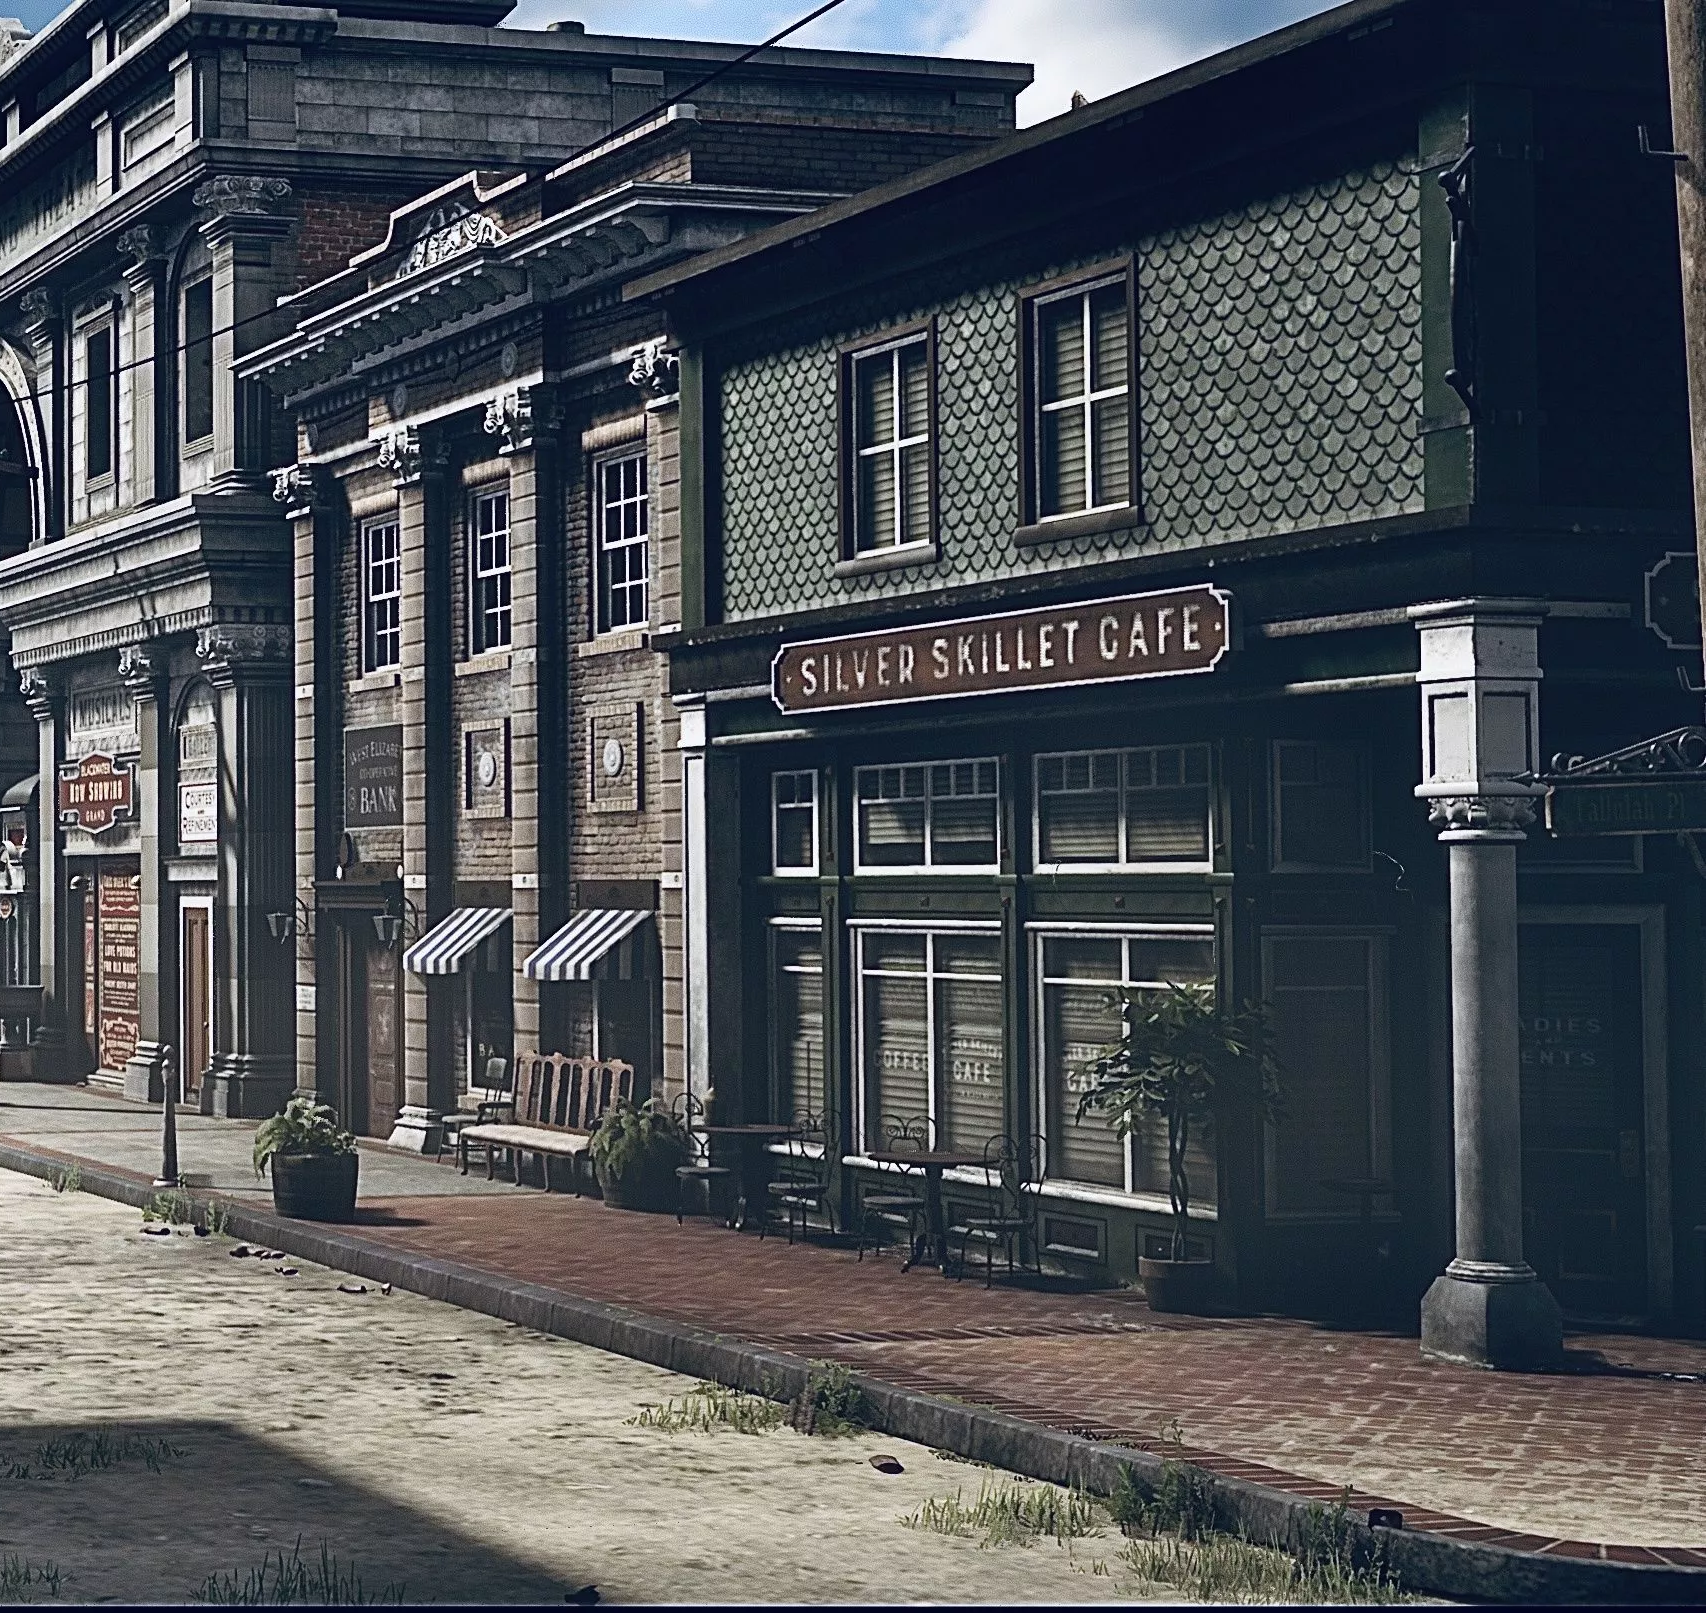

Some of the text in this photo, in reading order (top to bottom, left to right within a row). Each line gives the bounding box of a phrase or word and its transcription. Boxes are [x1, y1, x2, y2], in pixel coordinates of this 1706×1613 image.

[32, 169, 99, 237] THEATR
[801, 604, 1201, 697] SILVER SKILLET CAFE
[79, 690, 132, 727] MUSICALS
[349, 745, 369, 766] WEST
[69, 780, 123, 803] NOW SHOWING
[360, 786, 397, 814] BANK
[85, 809, 106, 823] GRAND
[183, 817, 217, 835] REFINEMEN
[1519, 1017, 1603, 1034] DIES
[1520, 1050, 1596, 1066] ENTS
[953, 1060, 991, 1083] CAFE
